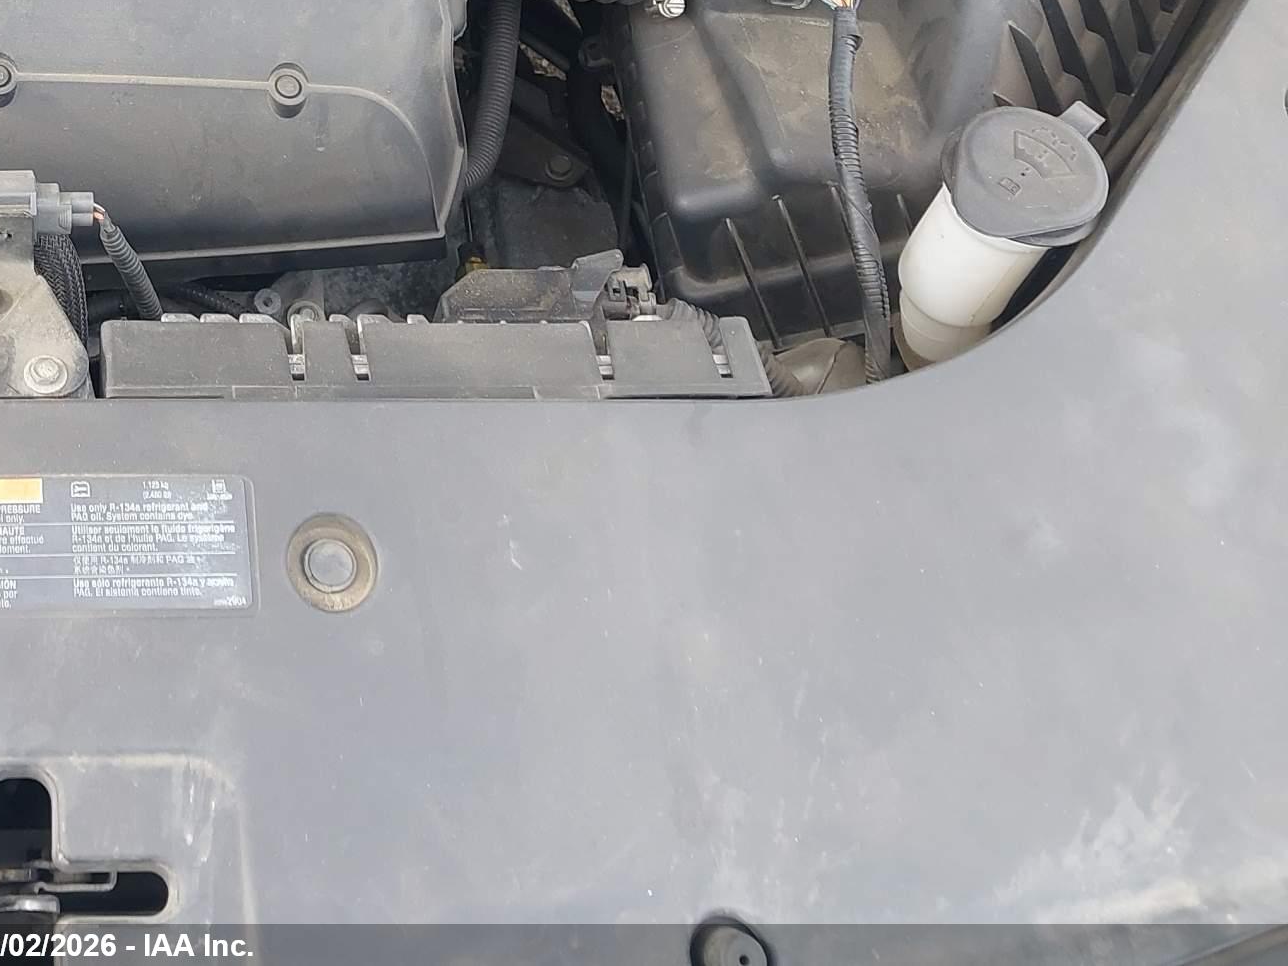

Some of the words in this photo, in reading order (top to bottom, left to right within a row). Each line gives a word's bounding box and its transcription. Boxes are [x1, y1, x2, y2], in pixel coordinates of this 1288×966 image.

[71, 504, 86, 512] Use
[89, 504, 106, 514] only
[109, 503, 140, 512] R-134a
[143, 502, 189, 513] refrigerant
[6, 513, 25, 525] only.
[107, 512, 138, 522] System
[140, 511, 176, 521] contains
[71, 524, 102, 534] Utiliser
[105, 524, 148, 534] seulement
[151, 524, 159, 533] le
[162, 523, 185, 533] fluide
[72, 535, 102, 543] R-134a
[105, 535, 112, 544] et
[115, 535, 125, 543] de
[177, 534, 187, 542] Le
[72, 543, 106, 552] contient
[109, 543, 119, 552] du
[122, 543, 158, 552] colorant.
[112, 577, 164, 588] refrigerante
[166, 577, 198, 587] R-134a
[3, 591, 17, 601] por
[106, 588, 139, 597] sistema
[142, 587, 179, 596] contiene
